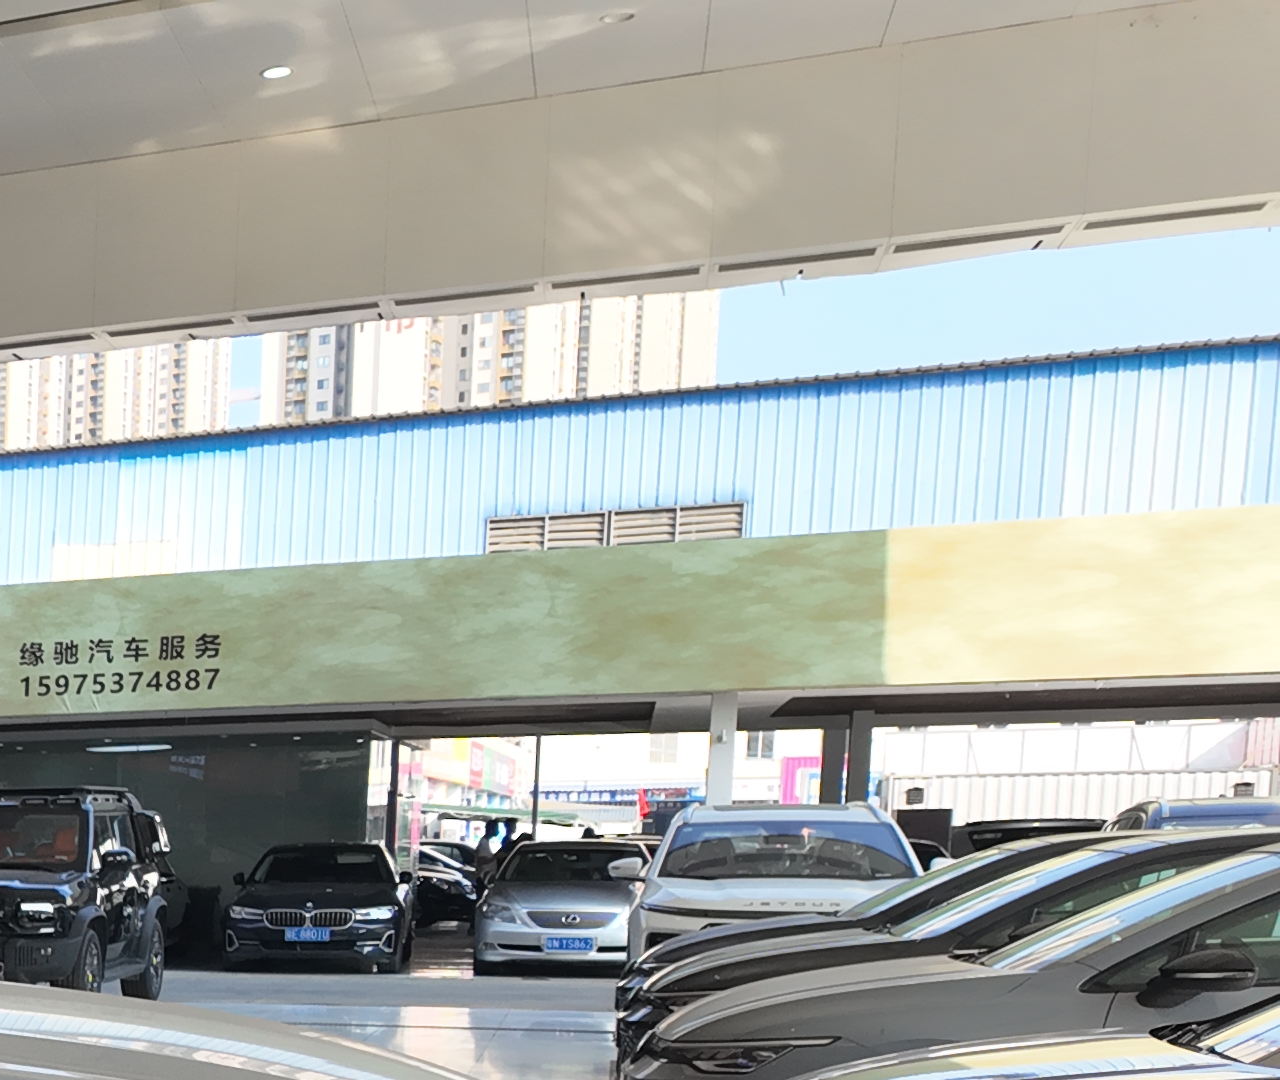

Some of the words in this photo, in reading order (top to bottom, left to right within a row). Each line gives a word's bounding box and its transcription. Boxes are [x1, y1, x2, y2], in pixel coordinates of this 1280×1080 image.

[19, 633, 221, 667] 缘驰汽车服务
[19, 669, 221, 697] 15975374887
